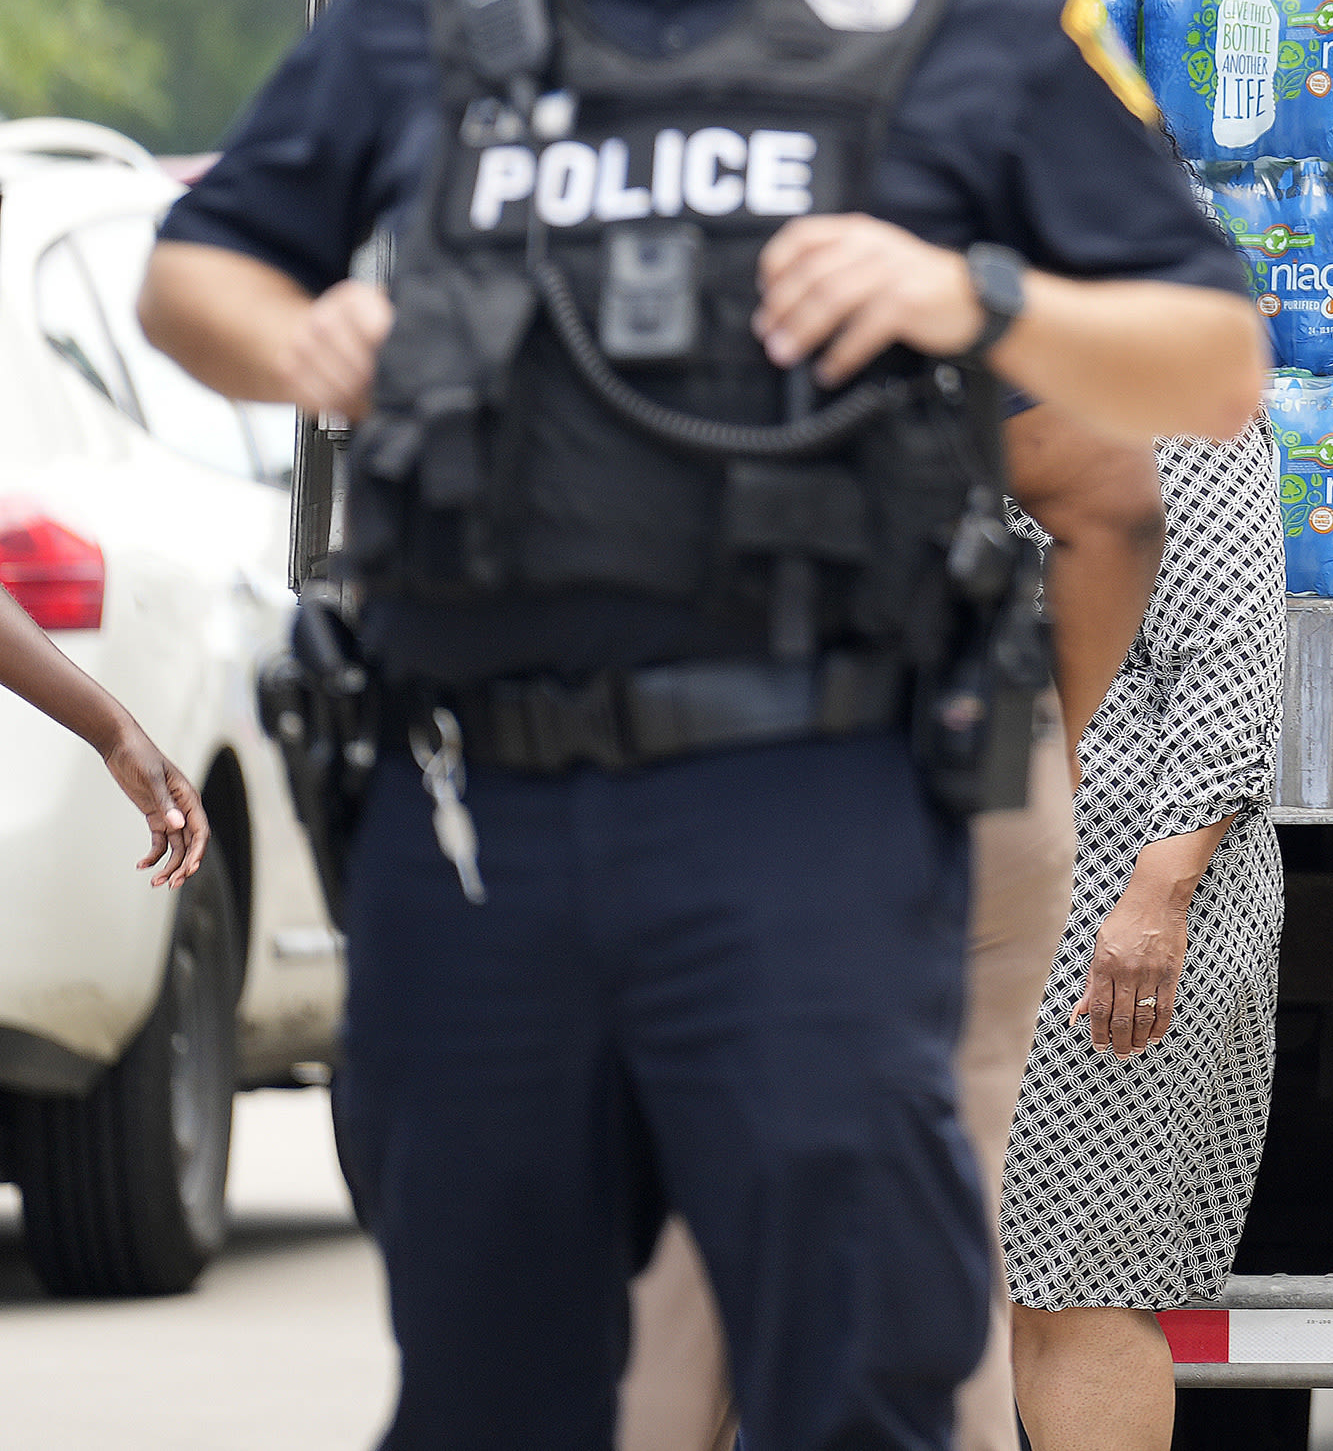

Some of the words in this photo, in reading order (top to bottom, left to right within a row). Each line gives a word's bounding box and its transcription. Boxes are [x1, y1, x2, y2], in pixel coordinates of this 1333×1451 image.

[1223, 0, 1249, 20] GIVE
[1250, 3, 1272, 24] THIS
[1223, 24, 1271, 54] BOTTLE
[1222, 54, 1269, 76] ANOTHER
[1222, 79, 1265, 119] LIFE
[469, 127, 818, 232] POLICE
[1283, 300, 1320, 311] PURIFIED
